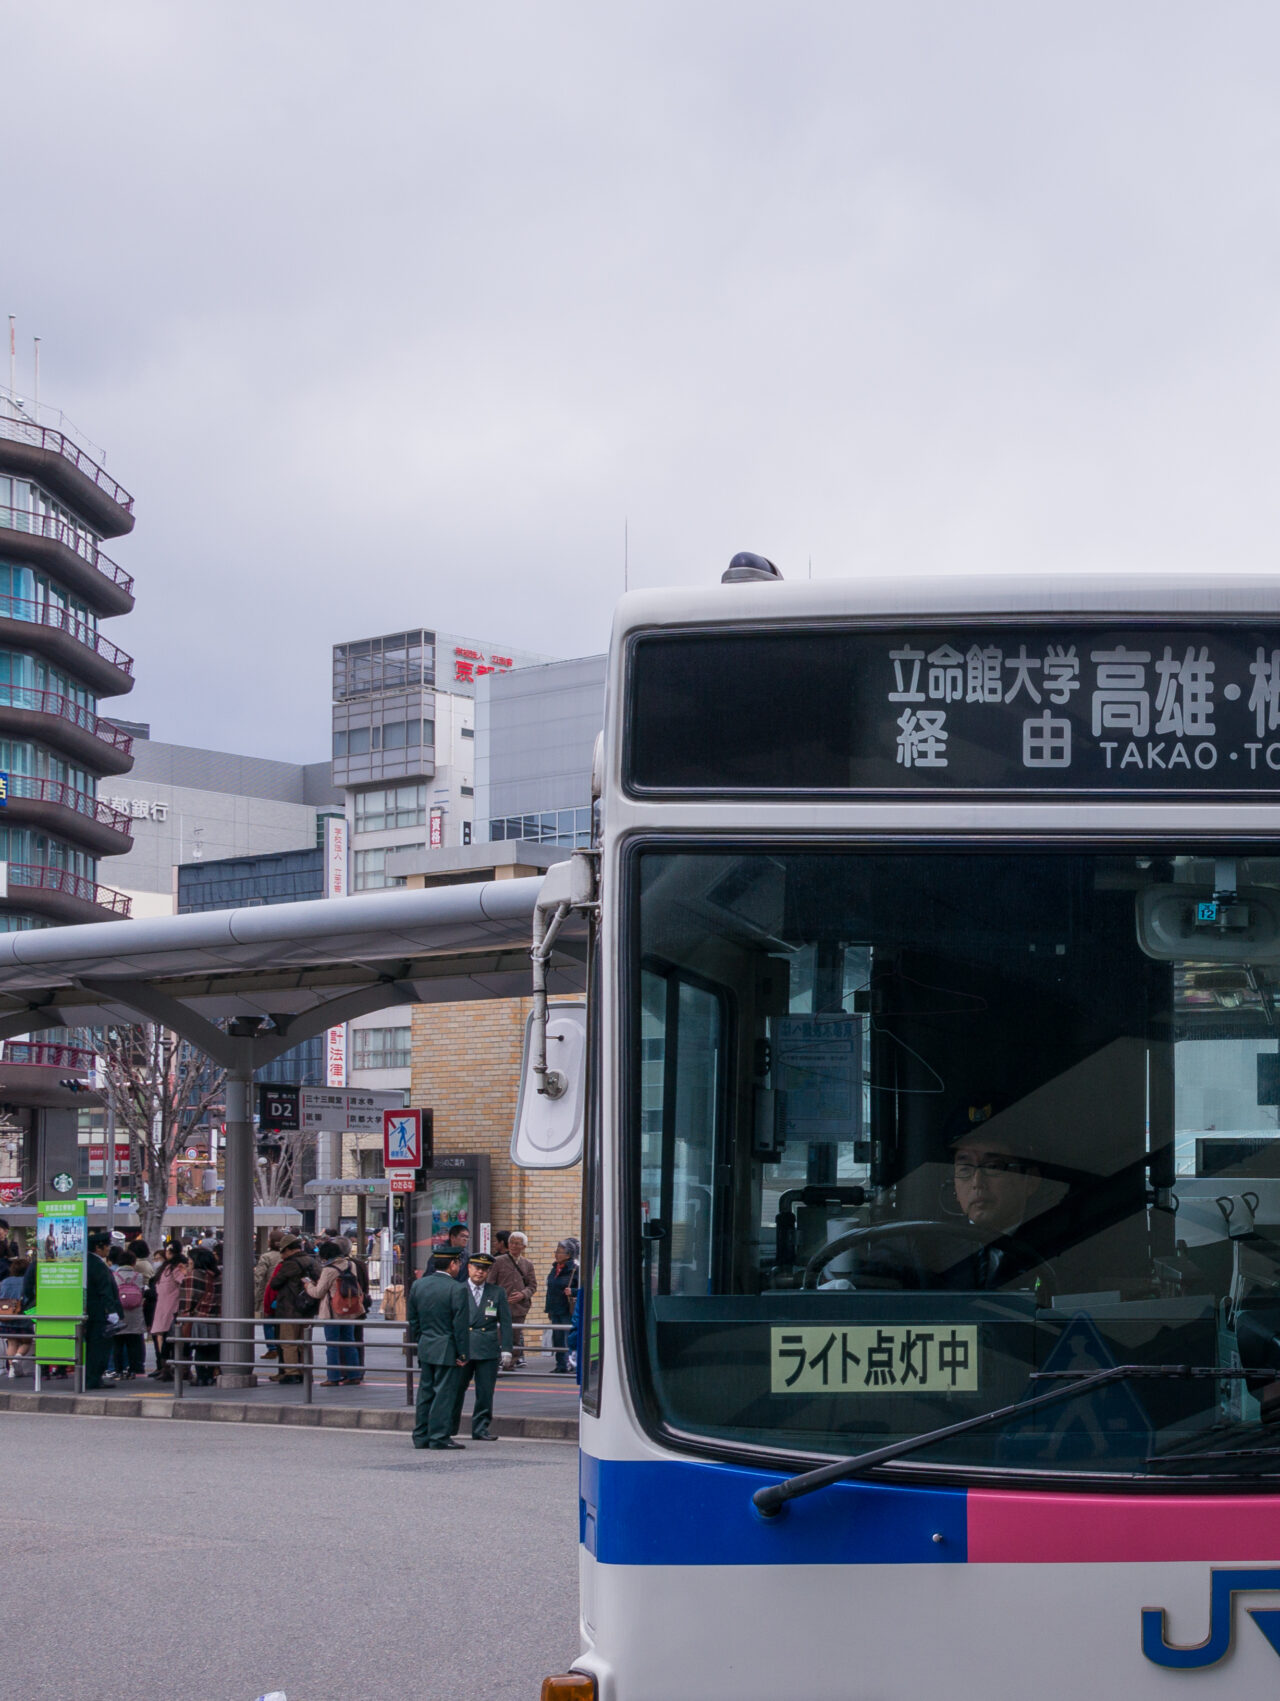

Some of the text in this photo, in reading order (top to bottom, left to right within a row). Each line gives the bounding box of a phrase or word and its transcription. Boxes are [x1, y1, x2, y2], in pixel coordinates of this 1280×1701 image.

[888, 644, 1080, 703] 立命館大学
[330, 1023, 344, 1076] 計法律
[271, 1102, 293, 1117] D2
[777, 1329, 970, 1388] ライト点灯中
